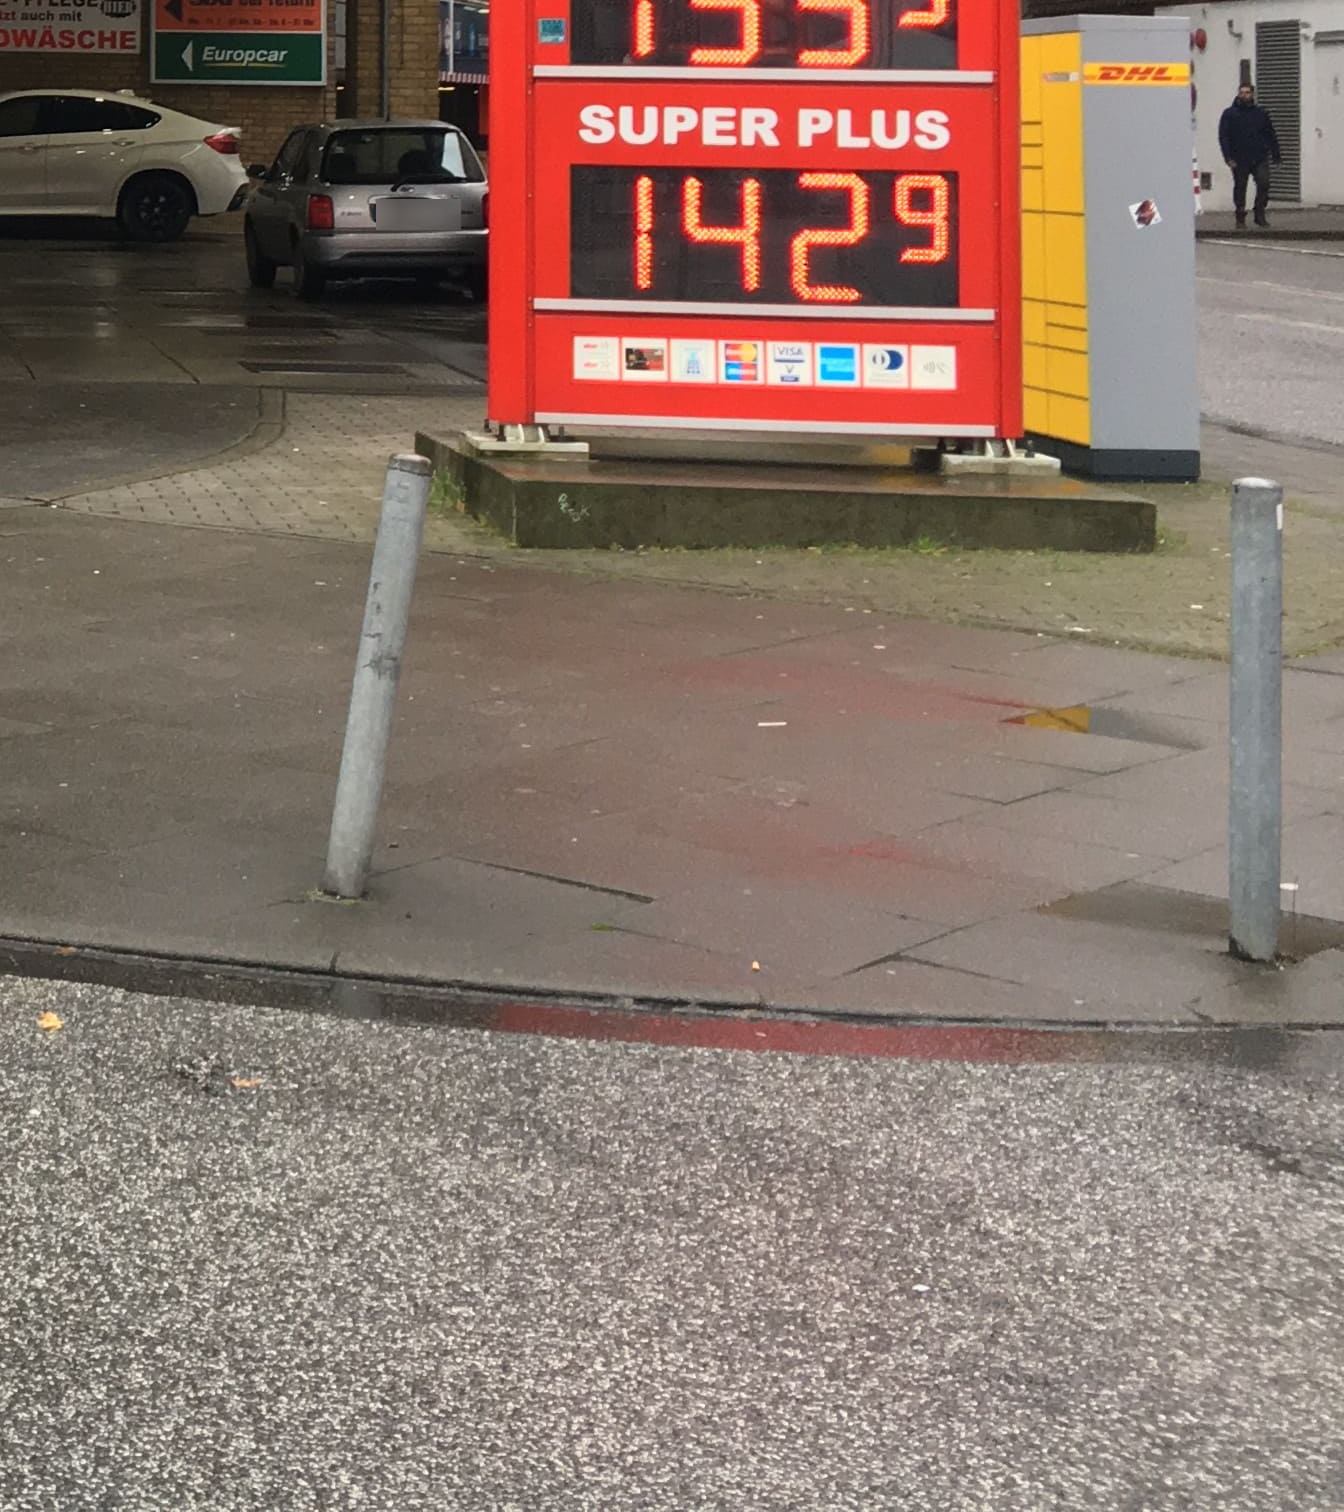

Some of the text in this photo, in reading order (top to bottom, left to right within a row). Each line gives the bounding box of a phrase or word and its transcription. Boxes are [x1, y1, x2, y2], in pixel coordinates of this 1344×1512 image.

[20, 10, 55, 21] auch
[59, 10, 83, 22] mit
[201, 46, 288, 67] Europcar
[1098, 66, 1173, 81] DHL
[578, 104, 951, 150] SUPER PLUS
[777, 346, 804, 356] VISA
